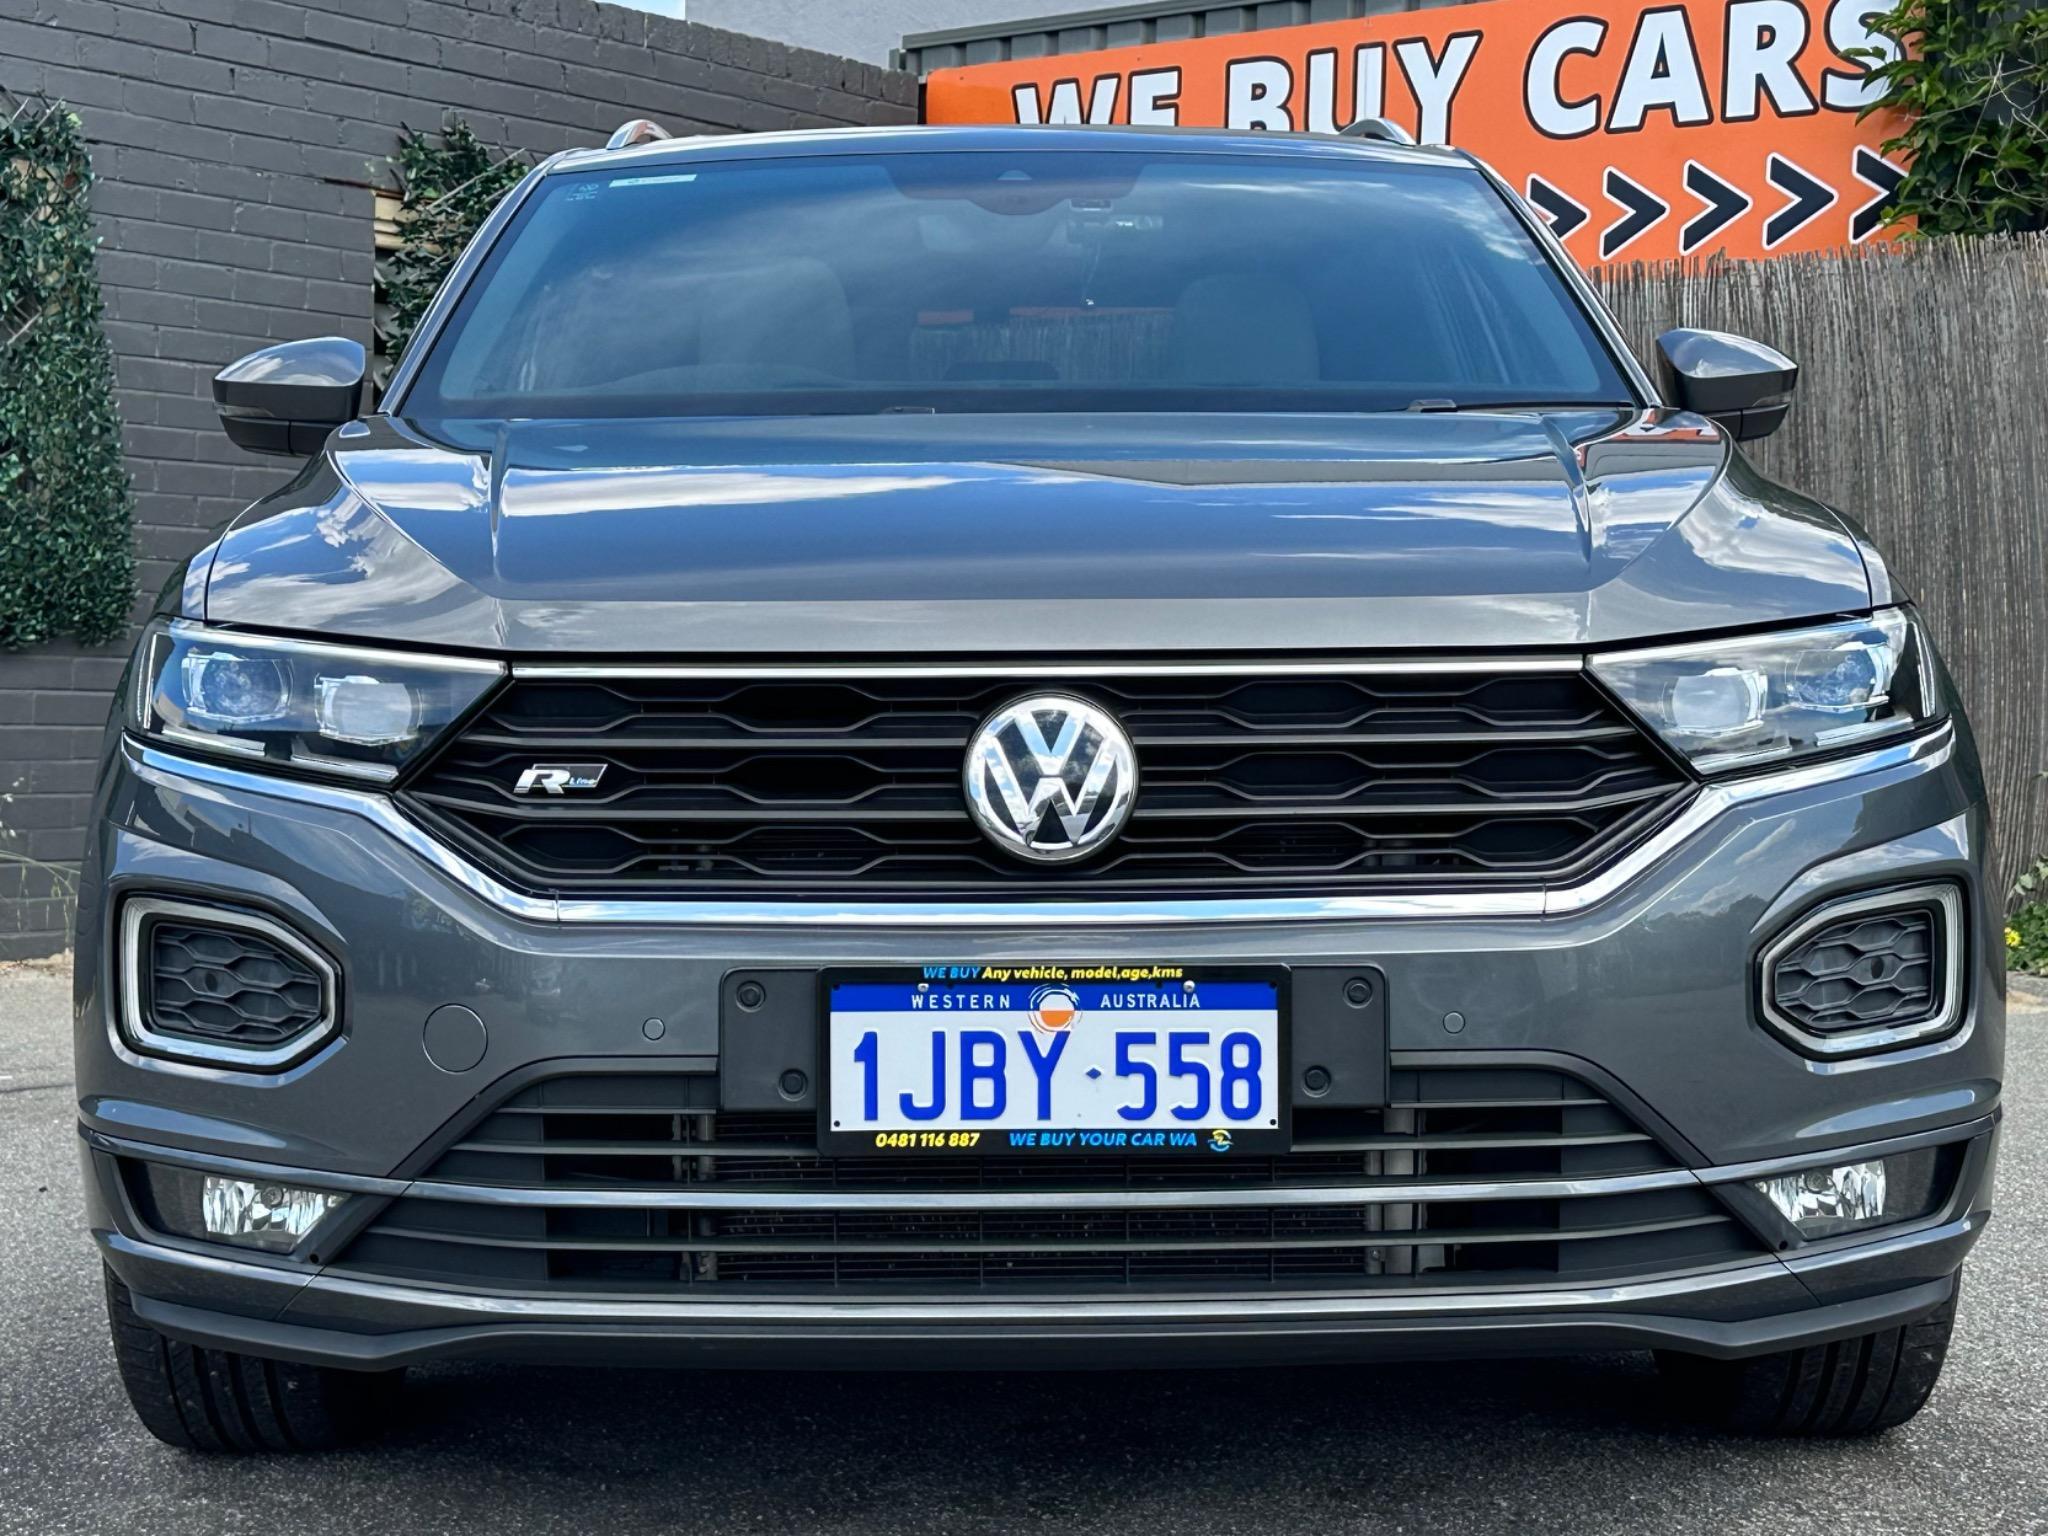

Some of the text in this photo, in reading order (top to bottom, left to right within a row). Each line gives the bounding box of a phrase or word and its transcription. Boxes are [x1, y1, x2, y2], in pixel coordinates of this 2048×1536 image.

[1224, 29, 1484, 147] BUY
[1523, 0, 1908, 140] CARS
[513, 769, 571, 794] R
[923, 966, 947, 979] WE
[949, 966, 981, 979] BUY
[981, 966, 1012, 982] Any
[1013, 966, 1068, 980] vehicle,
[911, 993, 1201, 1009] WESTERN AUSTRALIA
[853, 1030, 1263, 1122] 1JBY 558
[875, 1132, 981, 1148] 0481 116 887
[1009, 1132, 1198, 1146] WE BUY YOUR CAR WA
